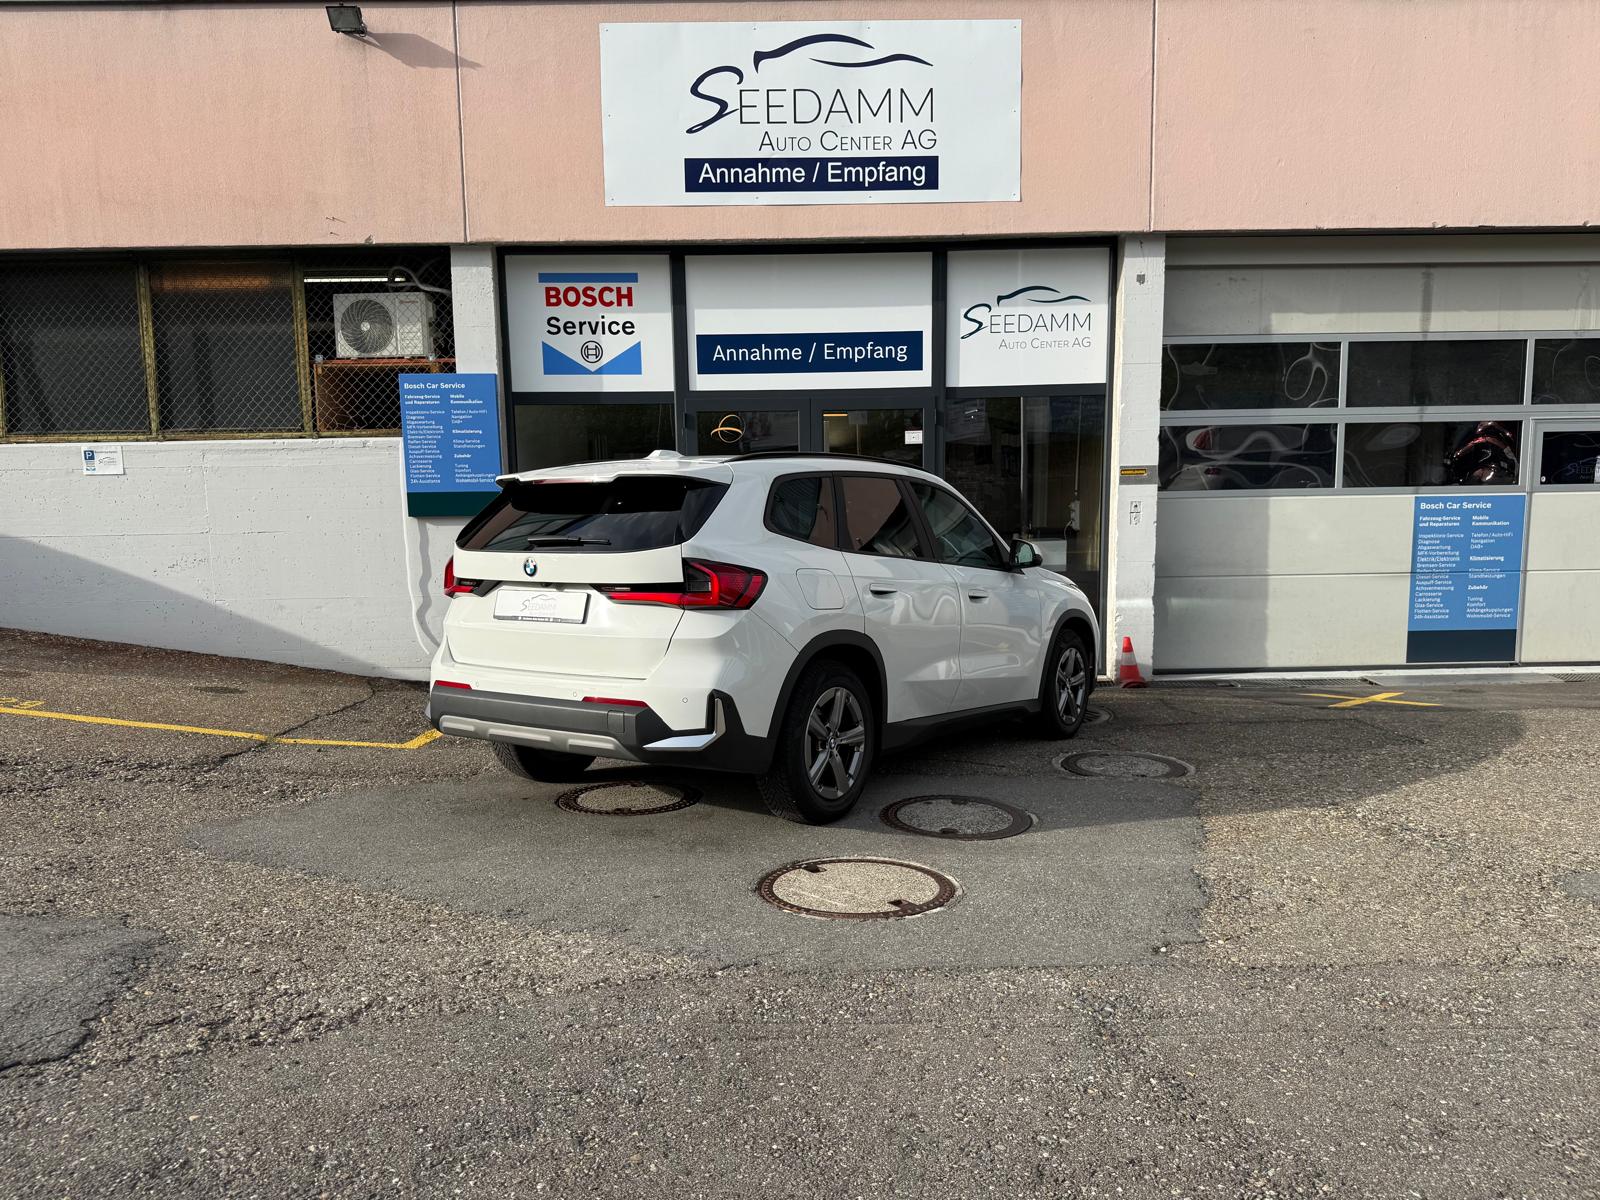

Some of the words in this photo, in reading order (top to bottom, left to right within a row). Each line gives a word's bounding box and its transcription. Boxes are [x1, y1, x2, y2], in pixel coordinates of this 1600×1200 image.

[686, 66, 934, 134] SEEDAMM
[901, 129, 937, 150] AG
[699, 163, 806, 184] Annahme
[812, 162, 820, 183] /
[827, 162, 926, 187] Empfang
[545, 286, 633, 307] BOSCH
[546, 315, 635, 335] Service
[961, 303, 1091, 339] SEEDAMM
[713, 344, 802, 362] Annahme
[808, 342, 816, 362] /
[824, 342, 908, 362] Empfang
[1072, 336, 1092, 348] AG
